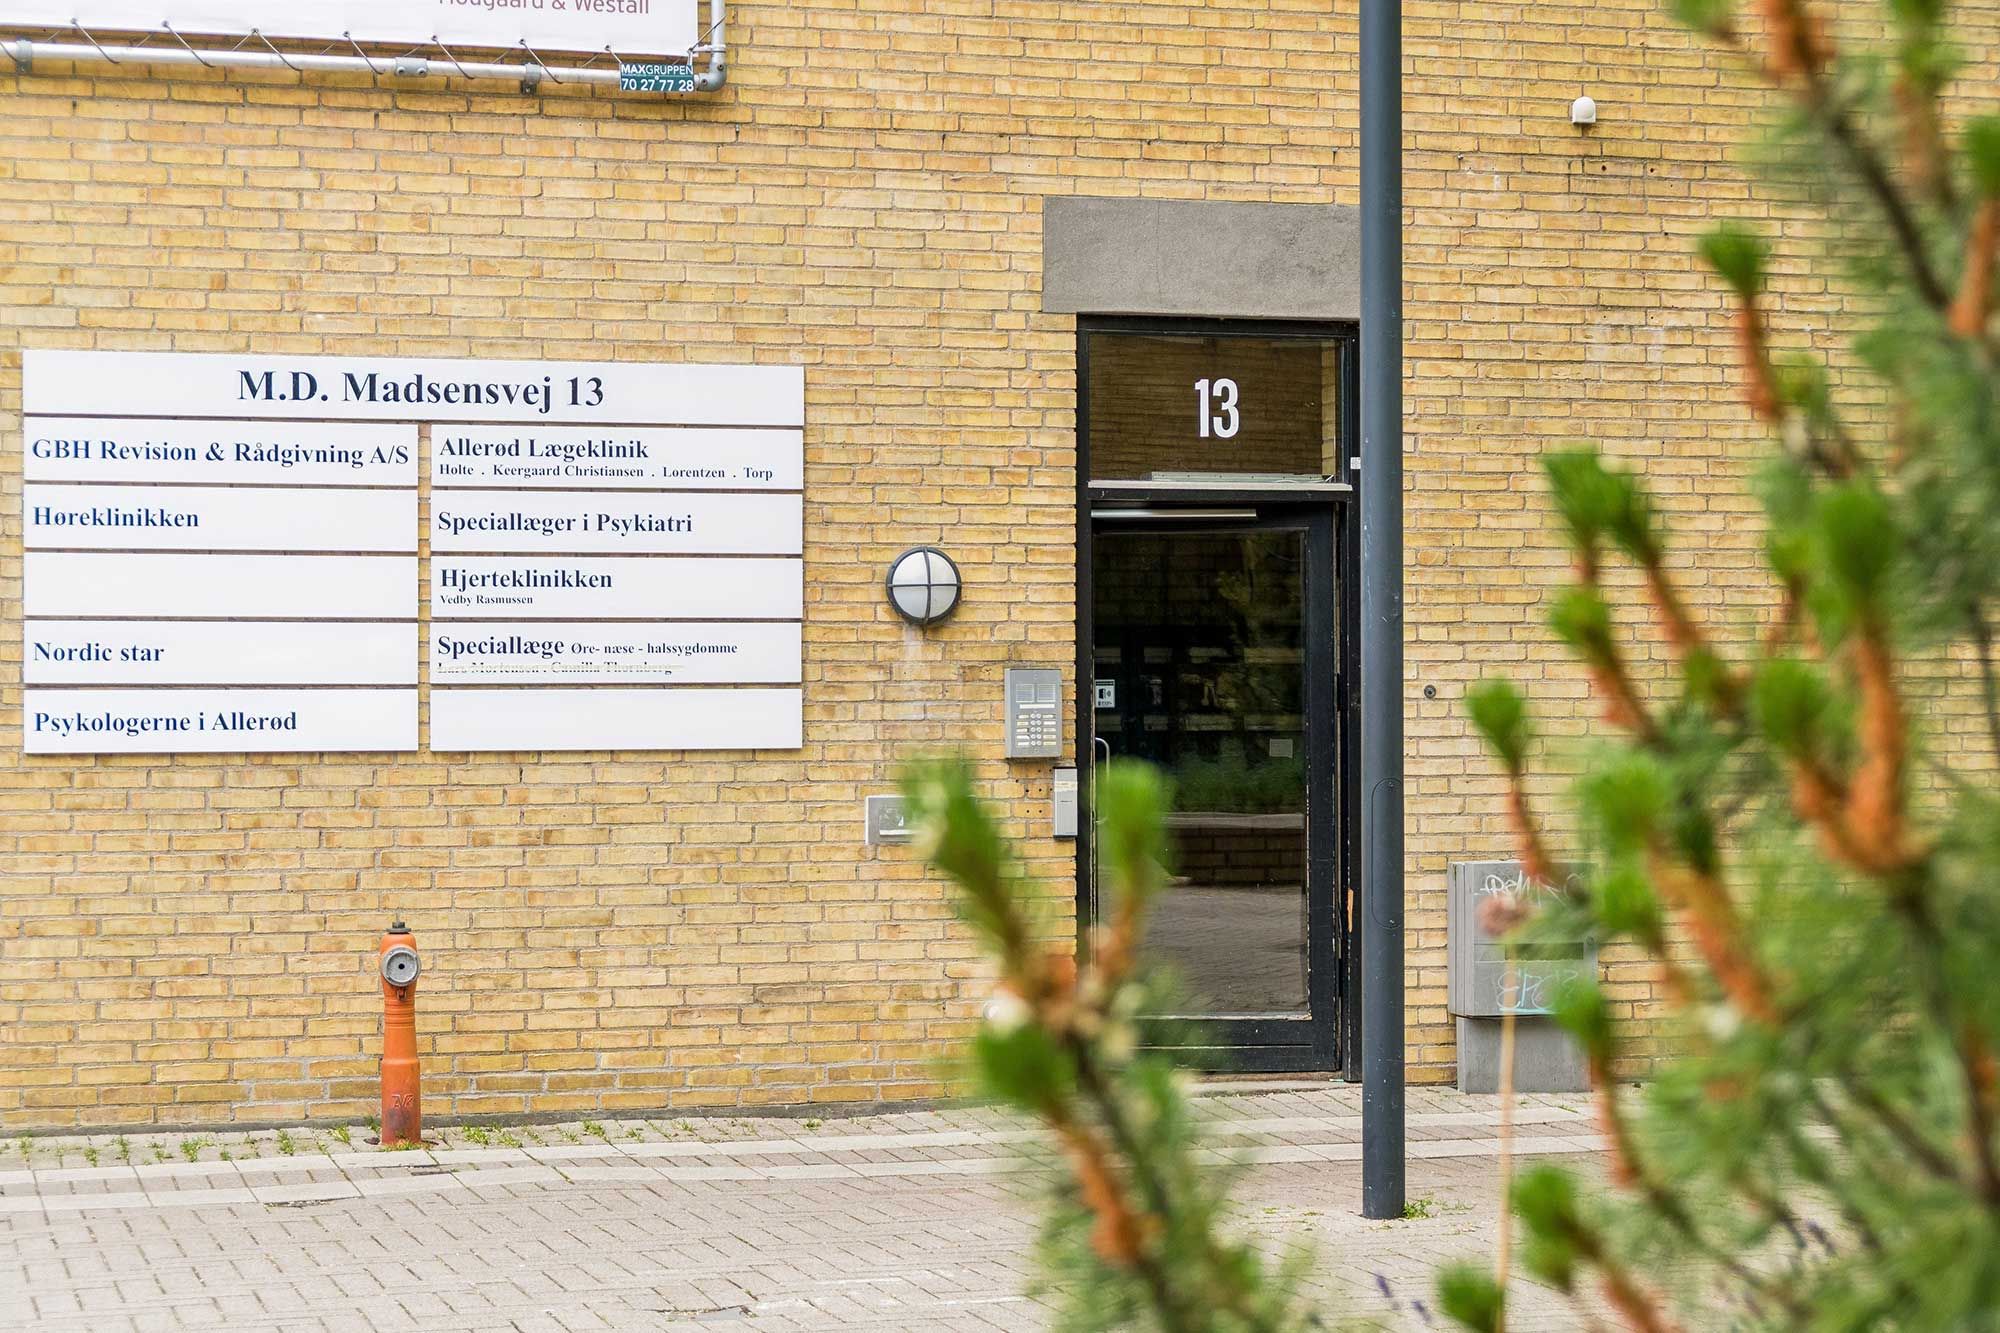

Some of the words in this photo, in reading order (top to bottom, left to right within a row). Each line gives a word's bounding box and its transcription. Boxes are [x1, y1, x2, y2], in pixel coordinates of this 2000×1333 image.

[438, 0, 545, 10] gaar
[574, 0, 650, 14] Westall
[621, 64, 693, 75] MAXGRUPPEN
[621, 78, 637, 90] 70
[640, 79, 656, 91] 27
[659, 79, 675, 91] 77
[678, 79, 694, 92] 28
[237, 369, 330, 402] M.D.
[341, 371, 552, 415] Madsensvej
[566, 375, 604, 407] 13
[1194, 378, 1240, 438] 13
[32, 439, 91, 460] GBH
[100, 440, 198, 461] Revision
[205, 442, 225, 462] &
[234, 442, 365, 469] Rådgivning
[370, 445, 410, 466] A/S
[439, 437, 521, 458] Allerød
[528, 439, 650, 463] Lægeklinik
[439, 463, 475, 477] Holte
[564, 465, 645, 478] Christiansen
[662, 466, 726, 478] Lorentzen
[743, 467, 774, 482] Torp
[33, 505, 200, 528] Høreklinikken
[438, 510, 577, 537] Speciallæger
[582, 513, 590, 531] i
[596, 513, 694, 537] Psykiatri
[440, 568, 613, 592] Hjerteklinikken
[440, 594, 473, 607] Vedby
[475, 595, 534, 605] Rasmussen
[33, 641, 113, 662] Nordic
[119, 645, 166, 662] star
[437, 635, 565, 660] Speciallæge
[603, 644, 636, 655] næse
[647, 642, 739, 657] halssygdomme
[35, 711, 192, 738] Psykologerne
[198, 711, 206, 731] i
[211, 711, 298, 732] Allerød
